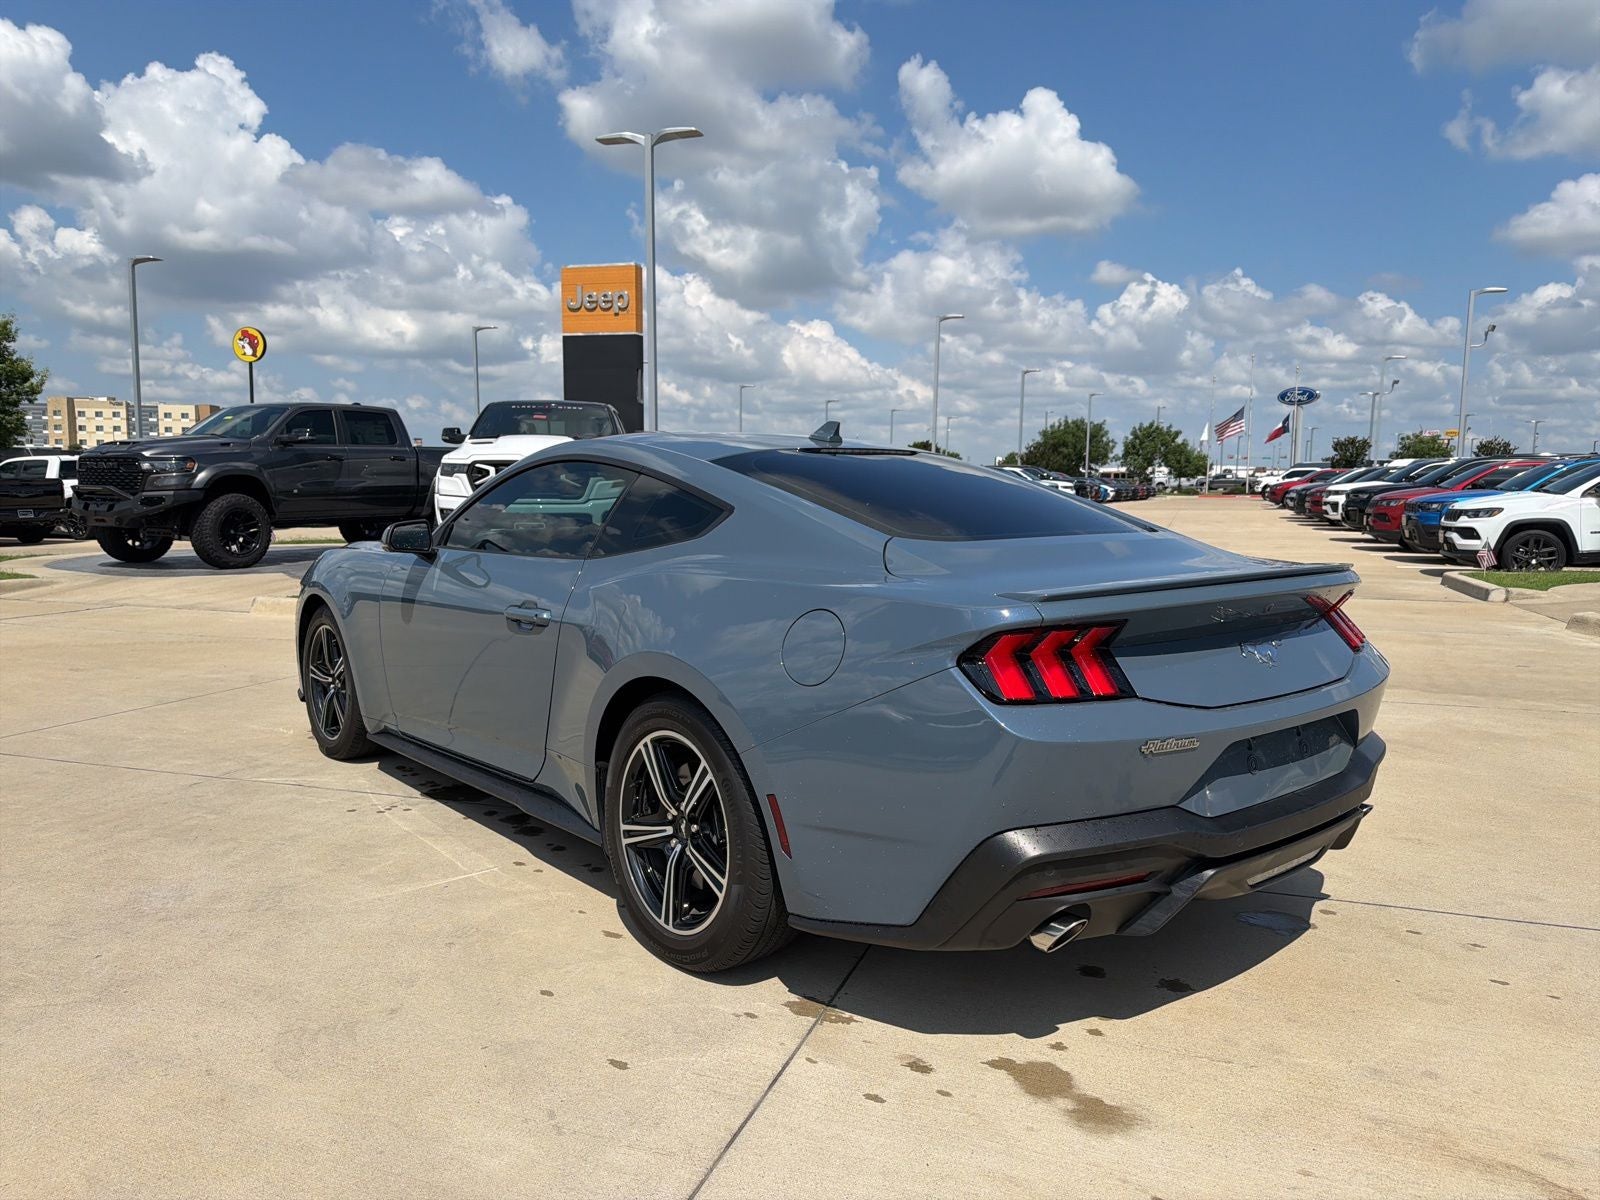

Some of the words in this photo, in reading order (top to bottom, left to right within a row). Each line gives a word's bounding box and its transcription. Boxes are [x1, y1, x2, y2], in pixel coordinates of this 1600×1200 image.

[567, 284, 630, 316] Jeep
[1284, 390, 1311, 402] Ford
[1141, 738, 1200, 755] Platinum
